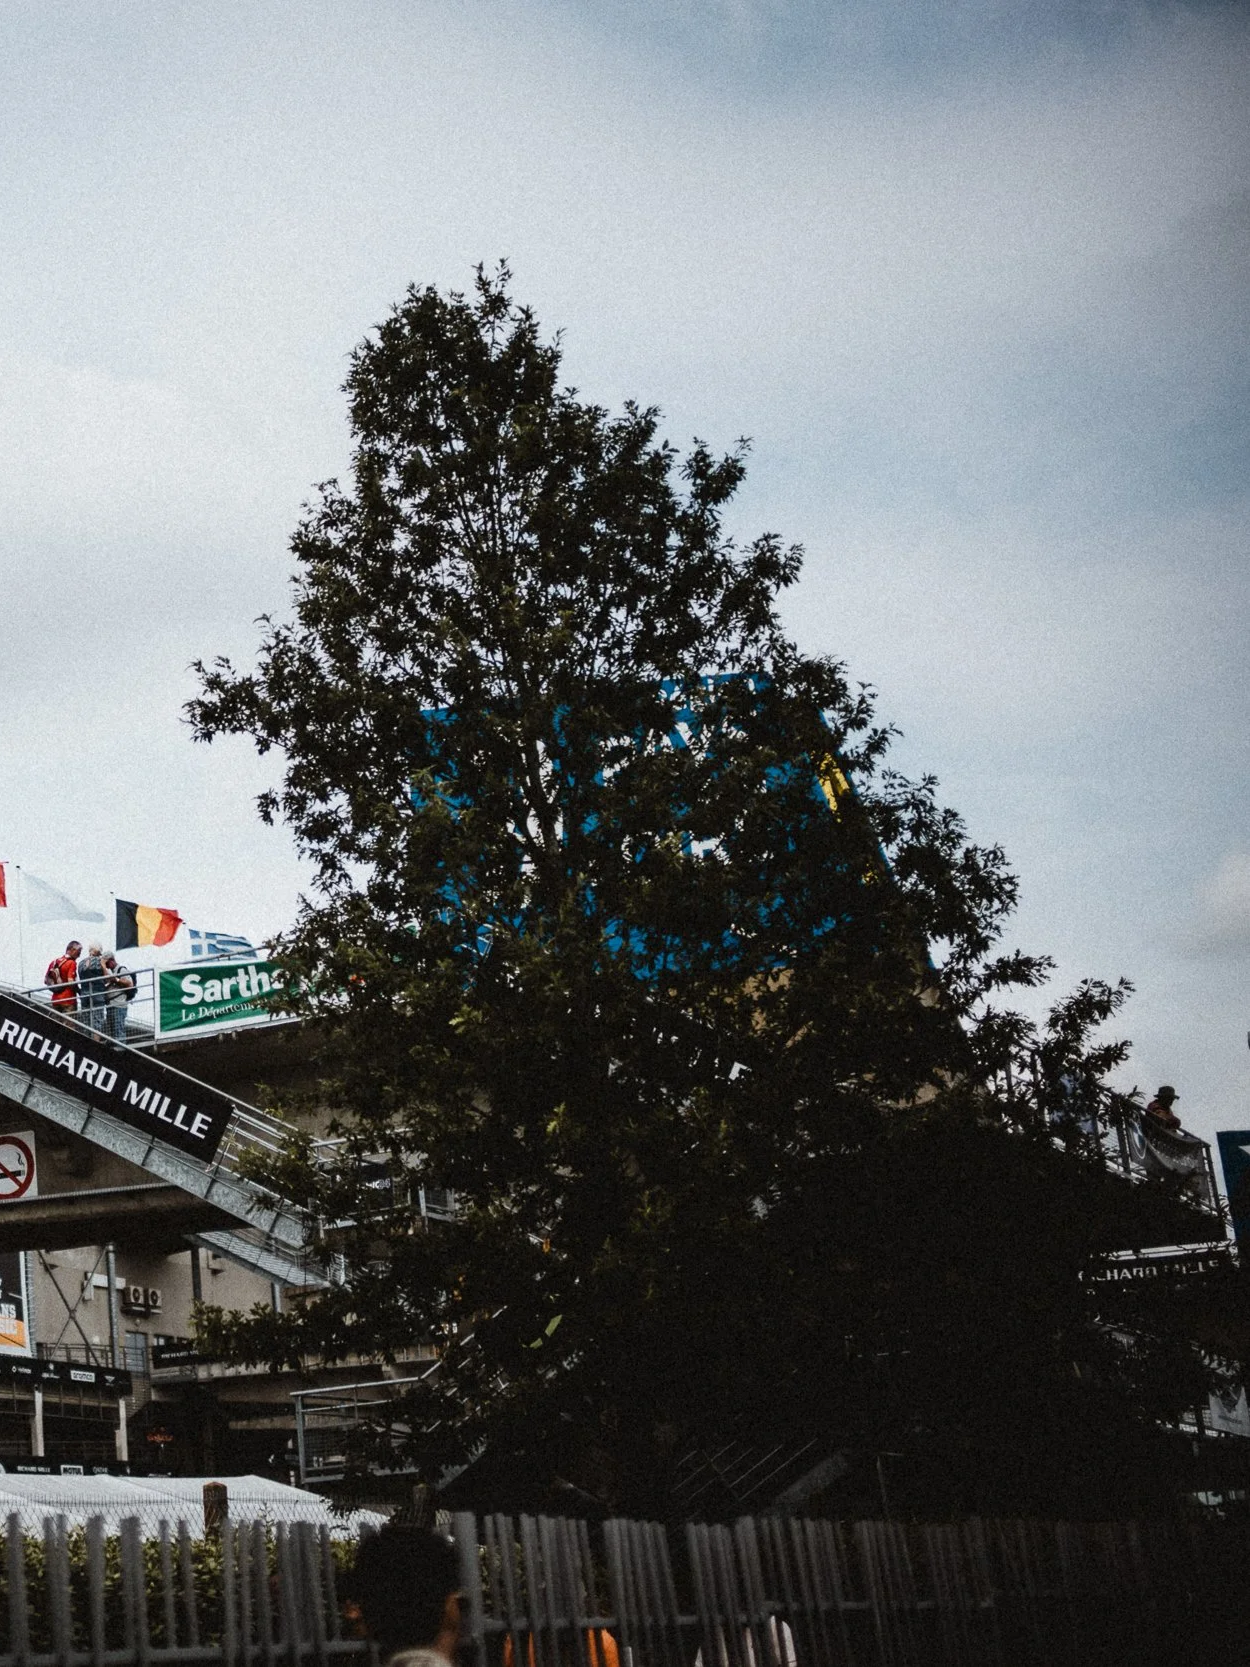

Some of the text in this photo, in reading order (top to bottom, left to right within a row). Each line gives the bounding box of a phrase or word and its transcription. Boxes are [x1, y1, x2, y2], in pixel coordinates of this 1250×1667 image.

[181, 999, 266, 1022] Le Départem
[123, 1080, 213, 1140] MILLE
